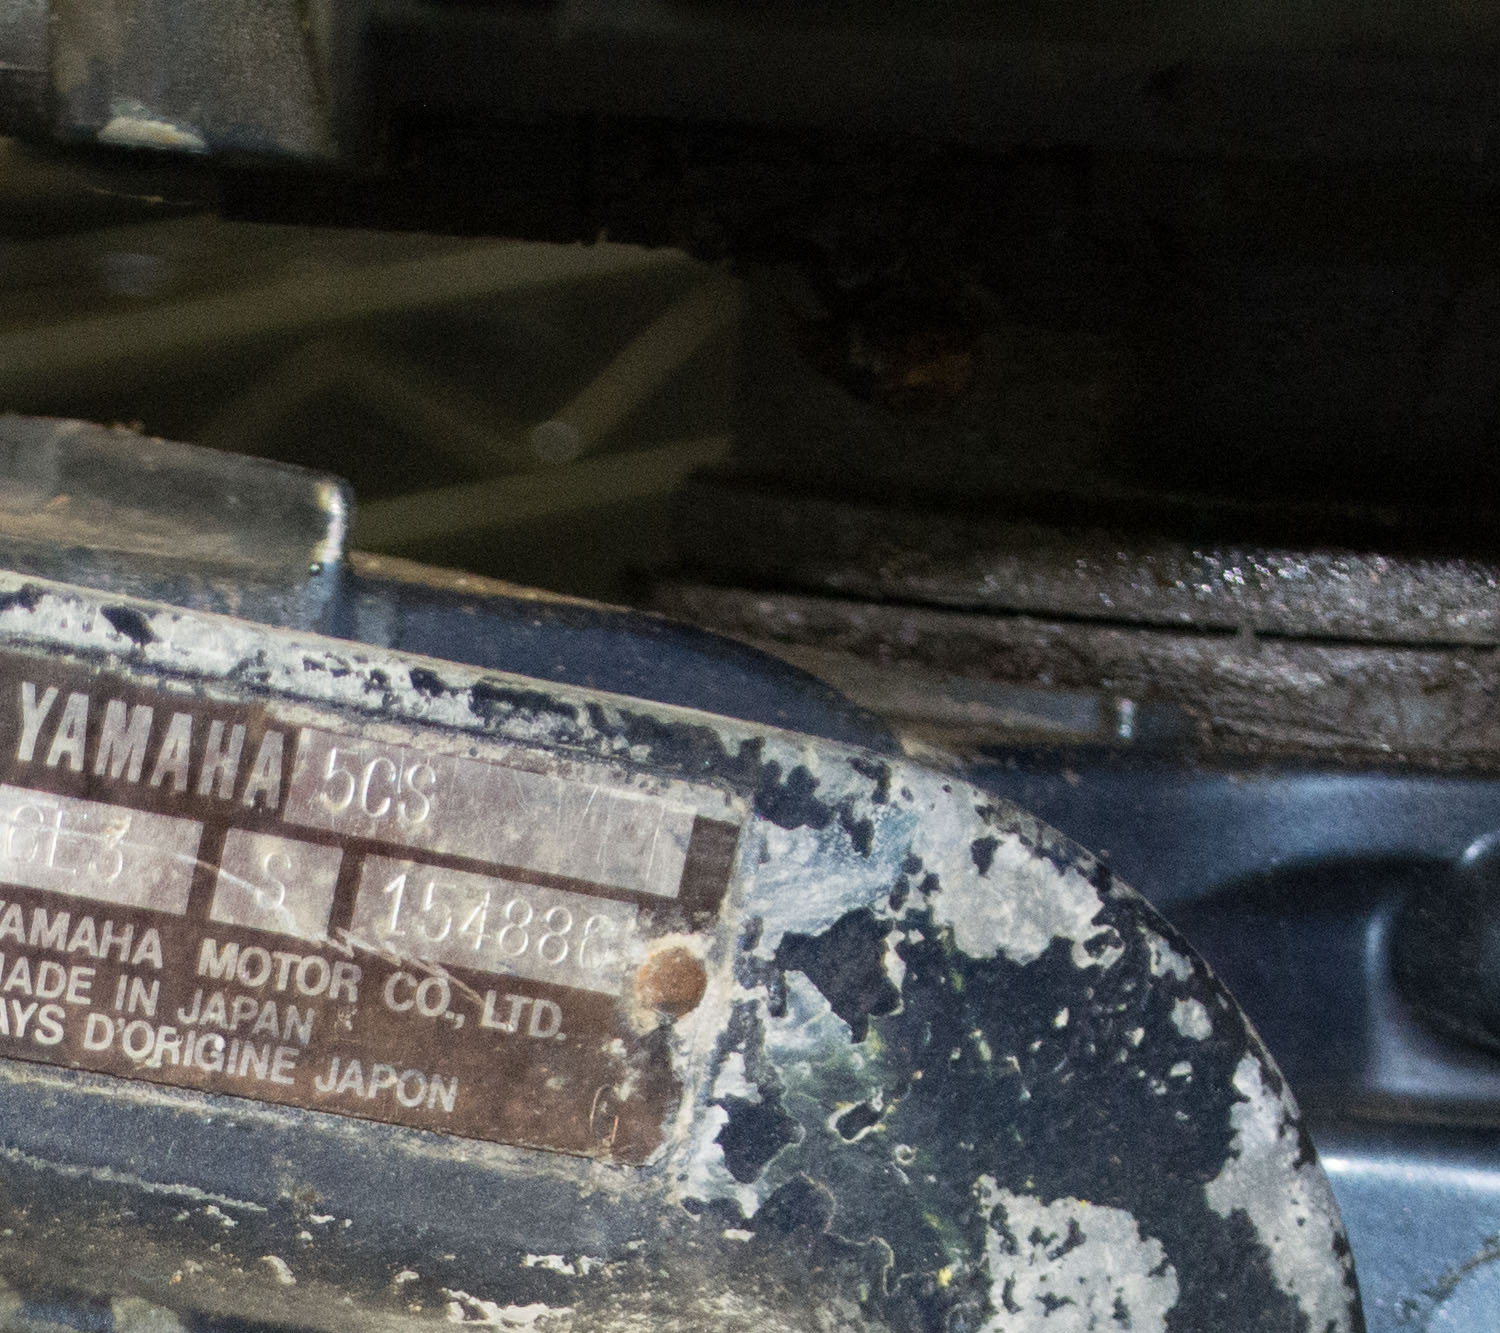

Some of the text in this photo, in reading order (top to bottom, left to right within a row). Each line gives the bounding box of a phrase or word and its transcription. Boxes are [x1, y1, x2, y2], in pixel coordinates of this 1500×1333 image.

[17, 681, 437, 824] YAMAHA 5CS
[260, 851, 292, 910] S
[197, 937, 362, 1002] MOTOR
[114, 974, 161, 1017] IN
[177, 988, 315, 1045] JAPAN
[83, 1012, 300, 1085] D'ORIGINE
[314, 1056, 460, 1114] JAPON
